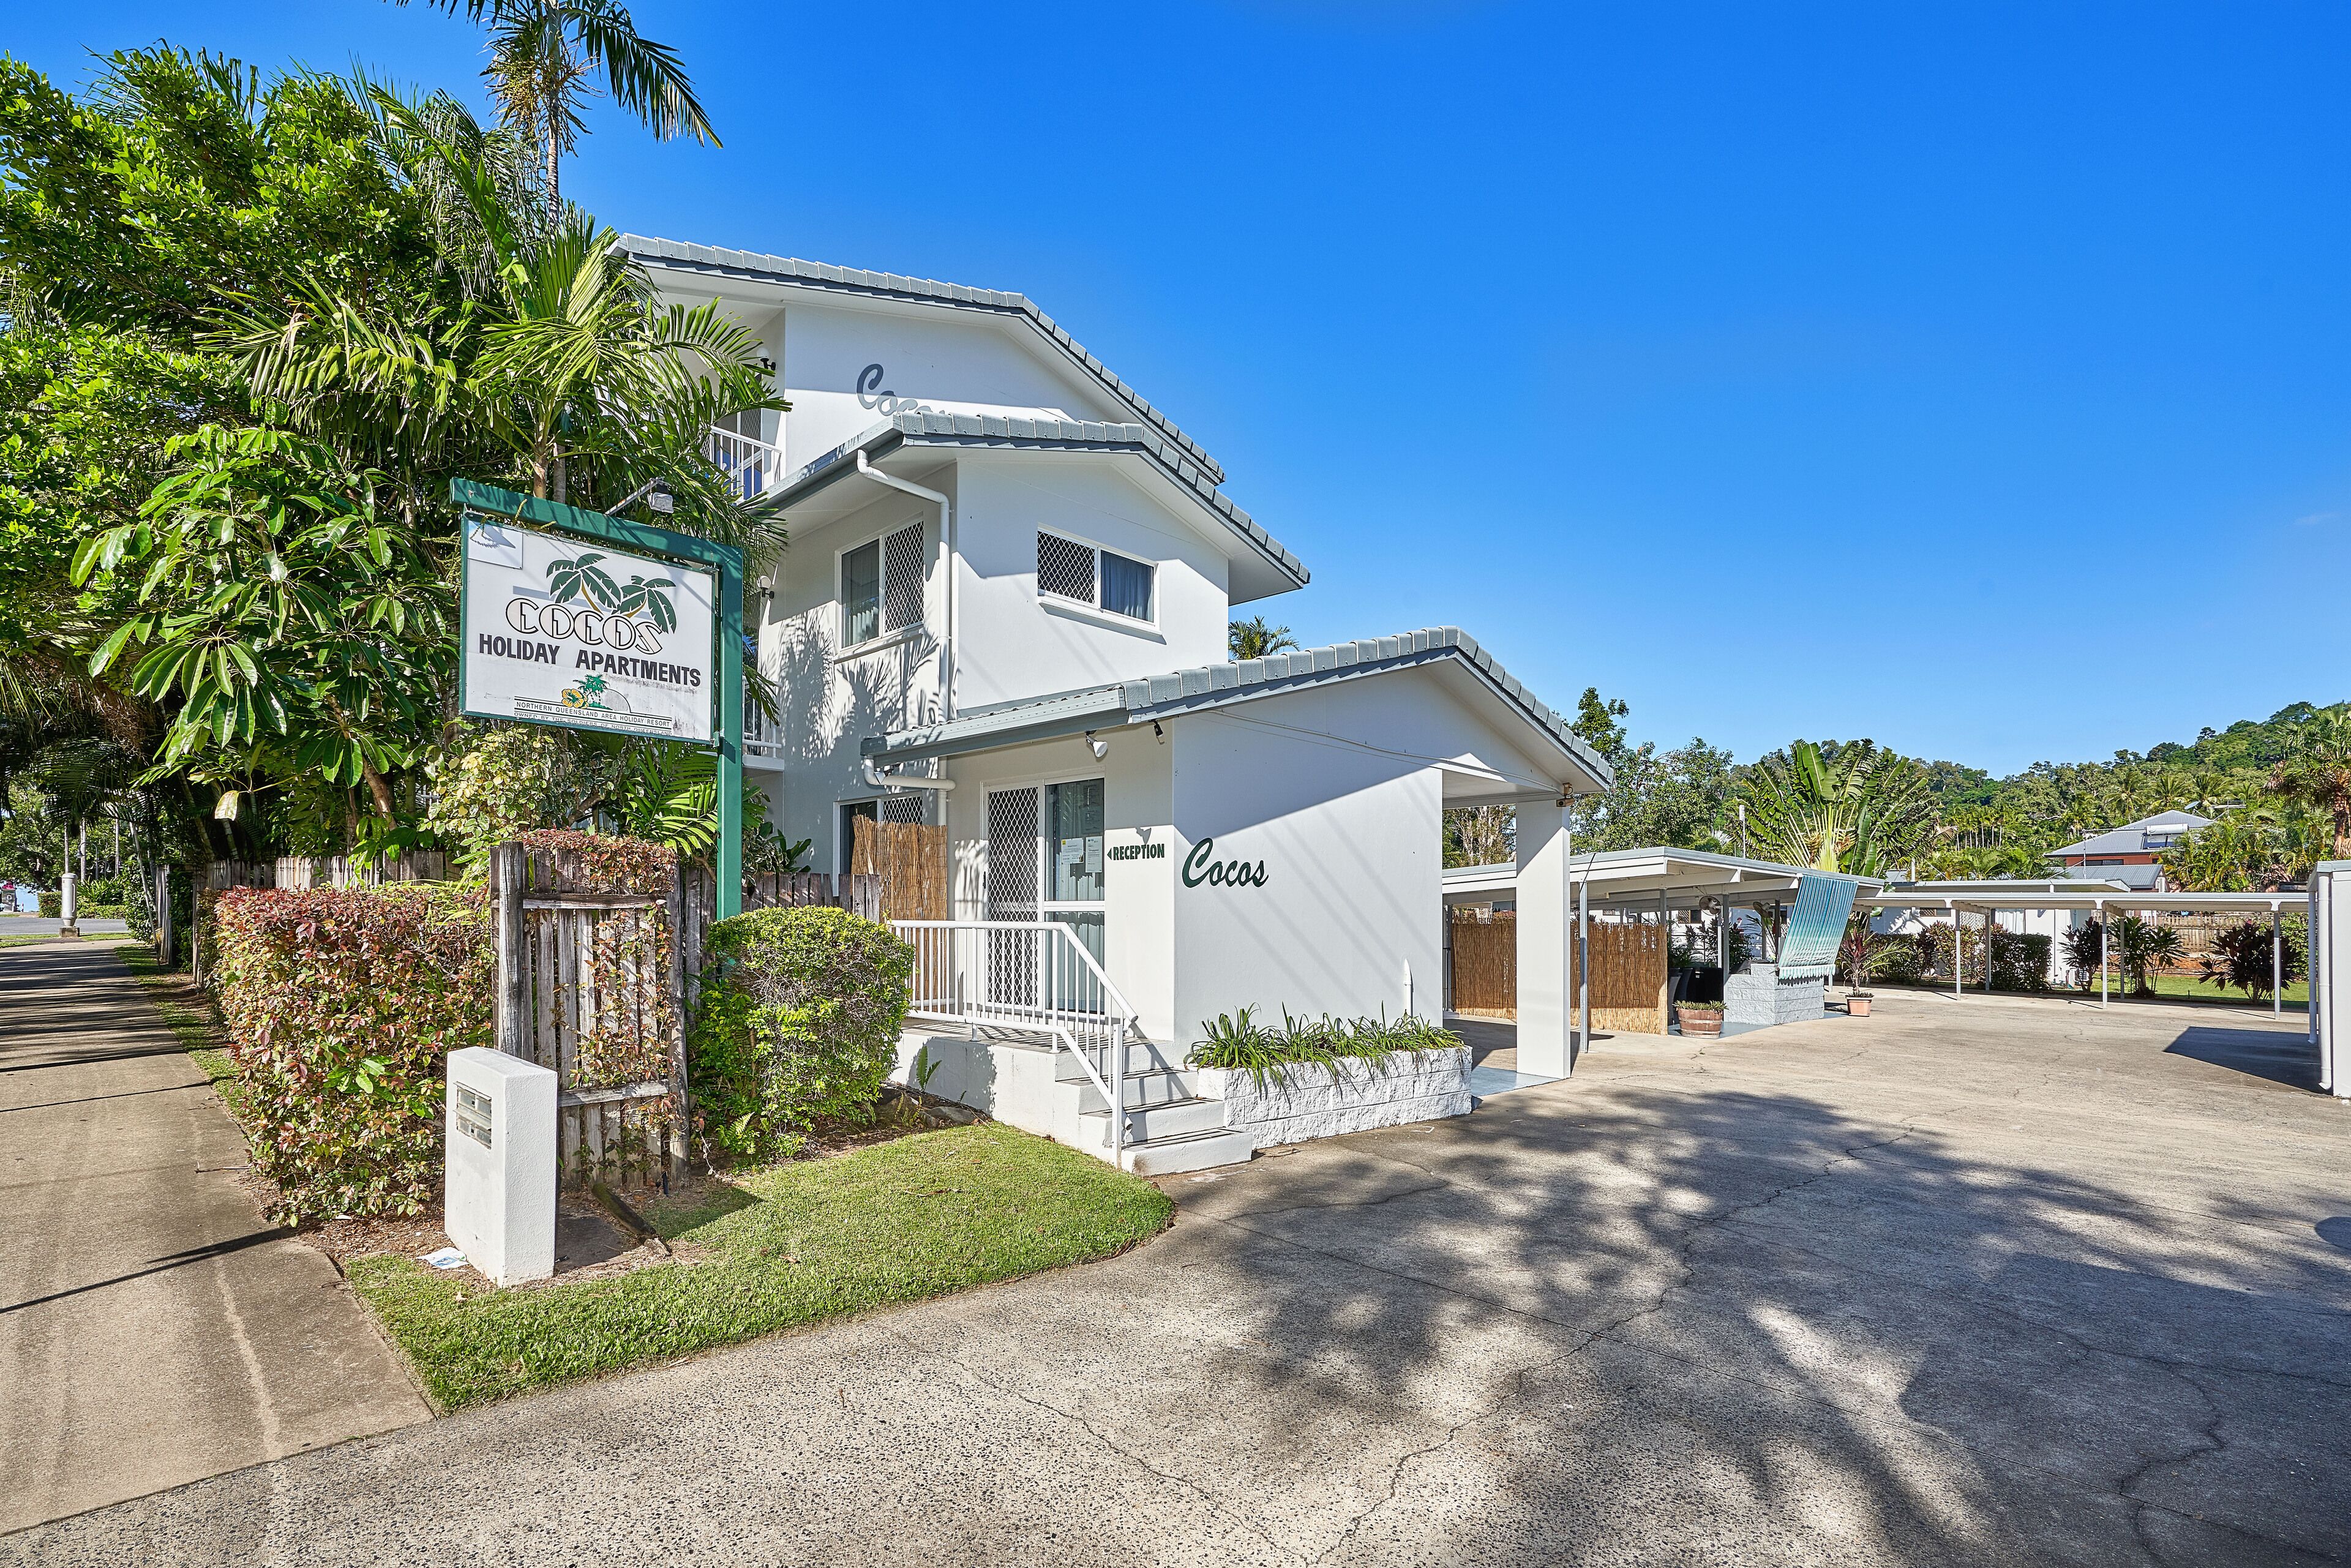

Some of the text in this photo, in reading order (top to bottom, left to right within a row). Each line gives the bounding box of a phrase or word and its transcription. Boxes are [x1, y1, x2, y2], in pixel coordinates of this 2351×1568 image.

[506, 598, 663, 655] COCOS
[479, 633, 701, 687] HOLIDAY APARTMENTS
[516, 702, 552, 711] NORTHERN
[556, 707, 598, 717] QUEENSLAND
[1113, 844, 1164, 860] RECEPTION
[1182, 838, 1269, 888] Cocos
